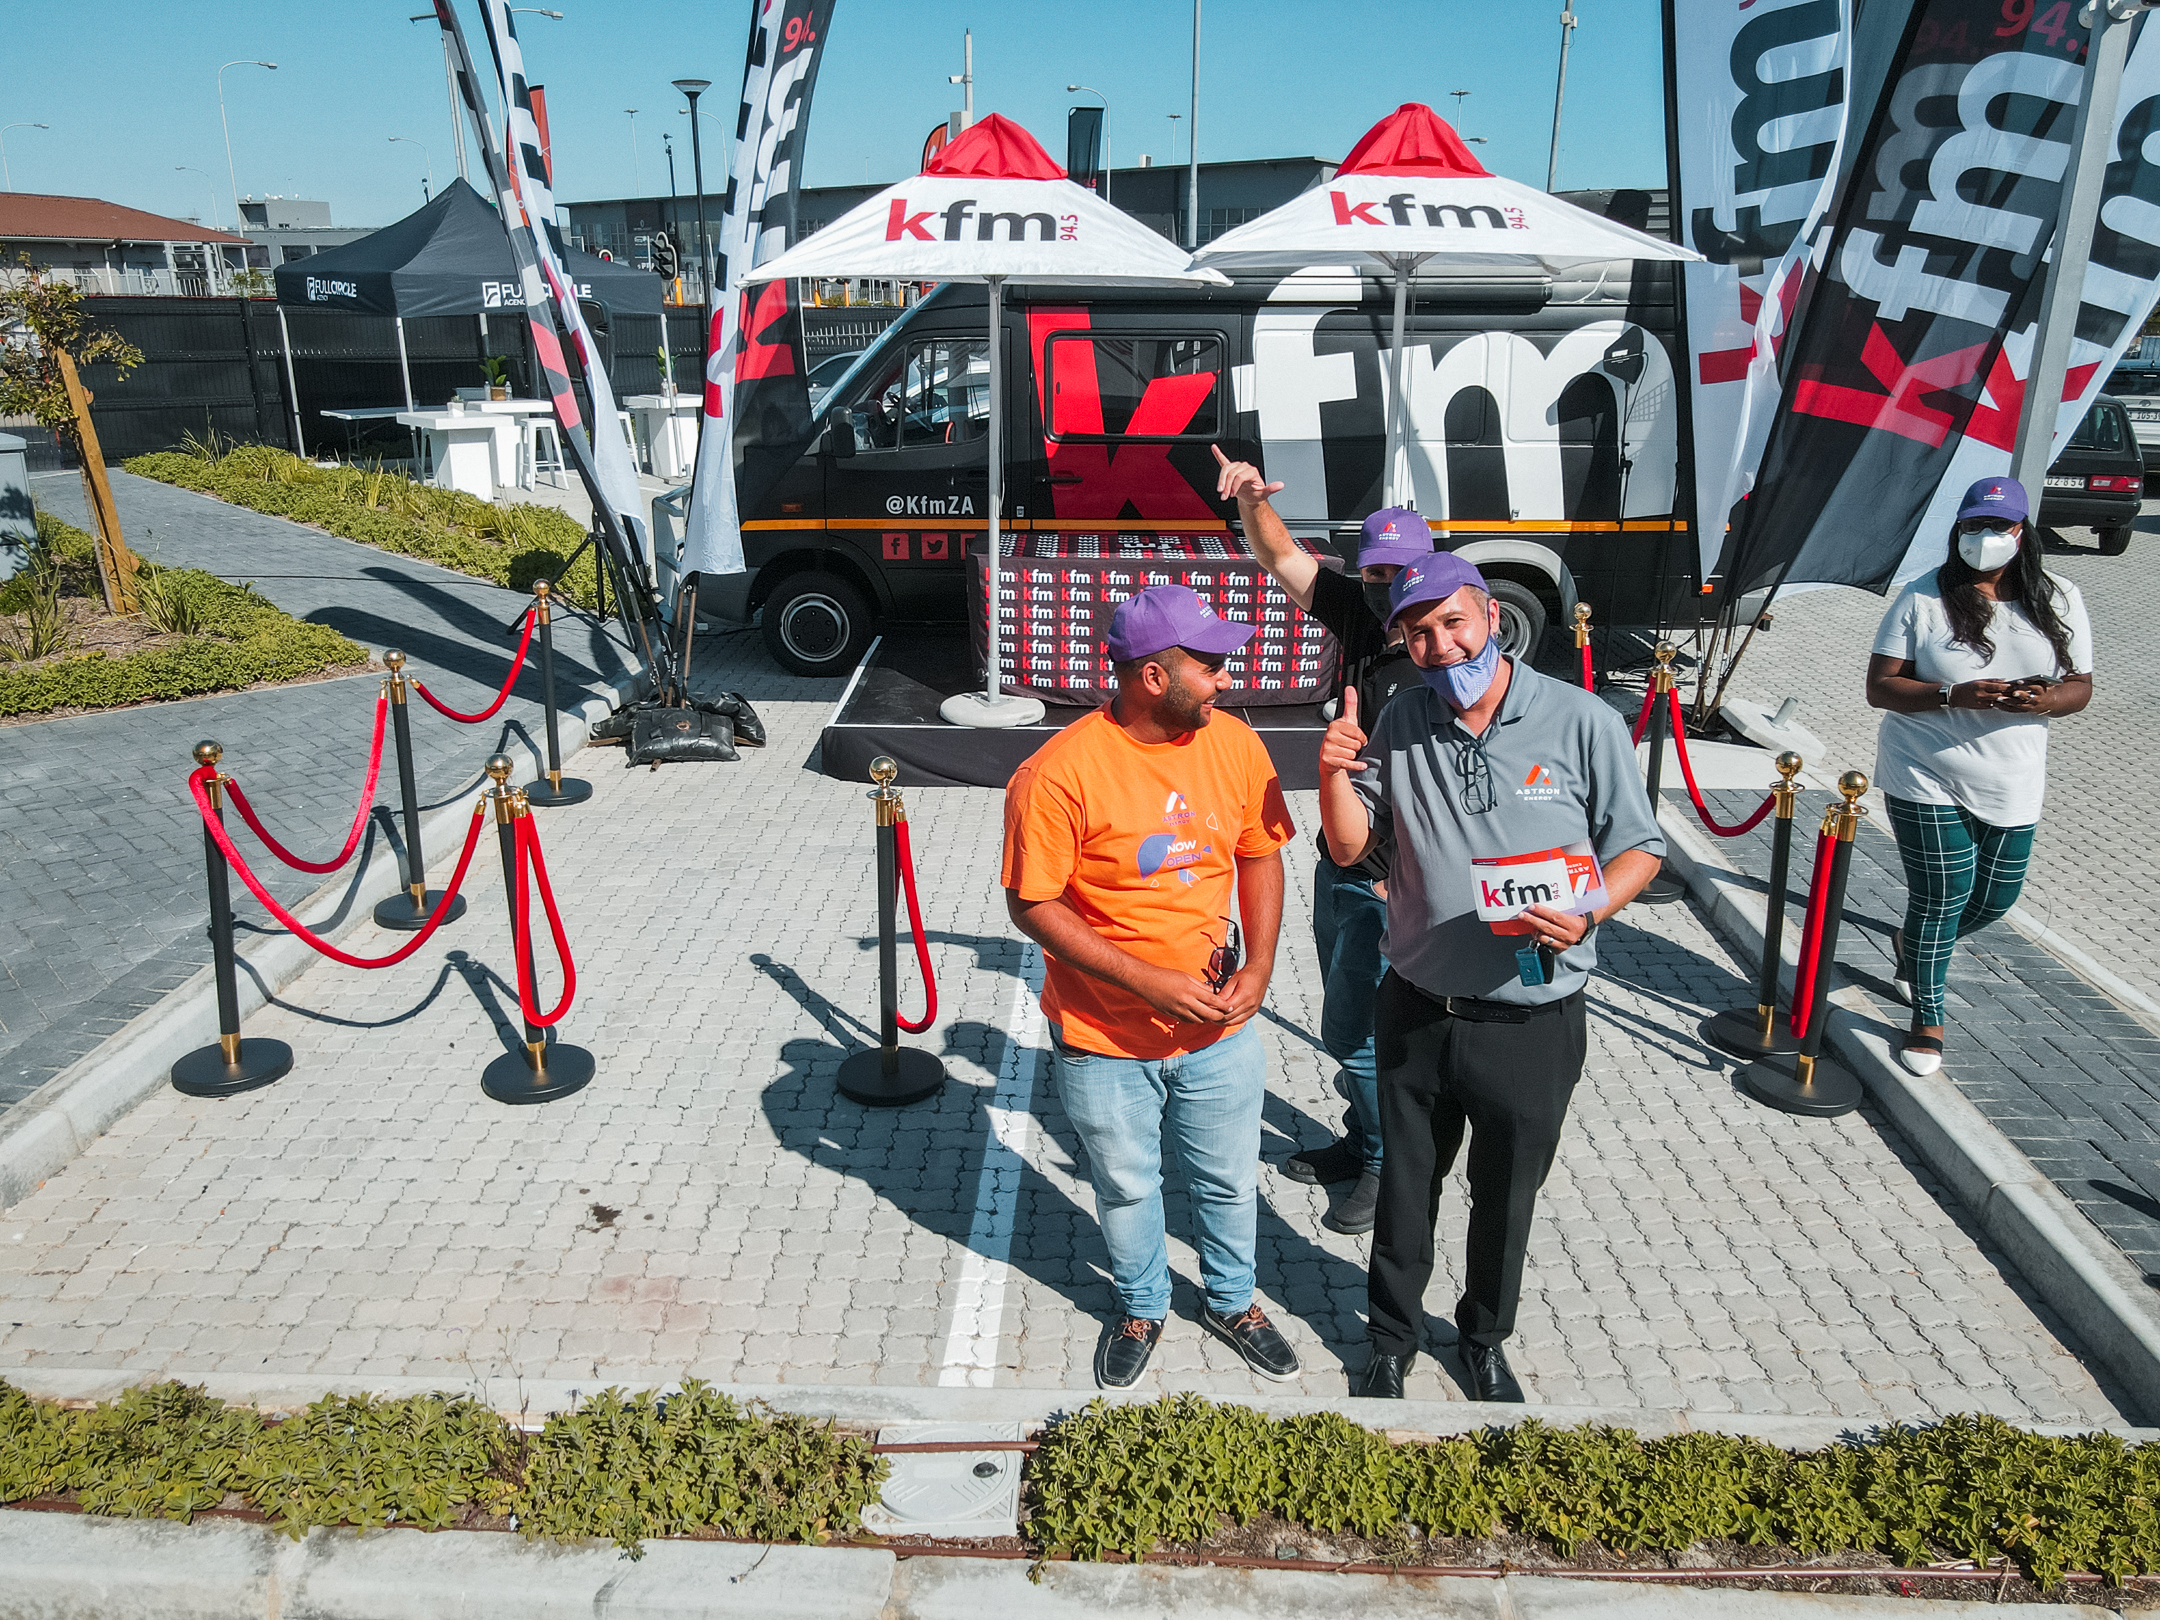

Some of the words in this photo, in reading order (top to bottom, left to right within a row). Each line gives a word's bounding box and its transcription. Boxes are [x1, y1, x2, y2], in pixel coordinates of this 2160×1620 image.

[1329, 190, 1509, 230] kfm
[1504, 206, 1531, 231] 94.5
[885, 198, 1057, 242] kfm
[1059, 213, 1079, 242] 94.5
[1791, 50, 2087, 450] kfm
[1024, 265, 1679, 537] kfm
[885, 494, 975, 515] @KfmZA
[1023, 568, 1053, 583] kfm
[1061, 569, 1091, 584] kfm
[1100, 570, 1130, 585] kfm
[1139, 571, 1169, 586] kfm
[1181, 571, 1212, 586] kfm
[1219, 572, 1249, 587] kfm
[1023, 586, 1053, 601] kfm
[1061, 587, 1091, 601] kfm
[1100, 588, 1130, 603] kfm
[1219, 590, 1249, 604] kfm
[1257, 590, 1287, 604] kfm
[1023, 604, 1053, 619] kfm
[1061, 605, 1091, 619] kfm
[1218, 607, 1248, 621] kfm
[1256, 608, 1285, 622] kfm
[1023, 621, 1053, 636] kfm
[1061, 622, 1090, 637] kfm
[1255, 624, 1284, 638] kfm
[1293, 624, 1323, 638] kfm
[1023, 639, 1053, 654] kfm
[1061, 640, 1090, 654] kfm
[1254, 642, 1284, 656] kfm
[1293, 642, 1321, 656] kfm
[1022, 656, 1052, 671] kfm
[1060, 657, 1090, 671] kfm
[1252, 658, 1282, 672] kfm
[1291, 658, 1318, 672] kfm
[1023, 674, 1053, 688] kfm
[1060, 675, 1089, 689] kfm
[1251, 676, 1281, 690] kfm
[1290, 675, 1317, 688] kfm
[1515, 787, 1561, 796] ASTRON
[1166, 839, 1197, 855] NOW
[1166, 852, 1202, 867] OPEN
[1480, 878, 1553, 908] kfm
[1549, 882, 1561, 900] 94.5
